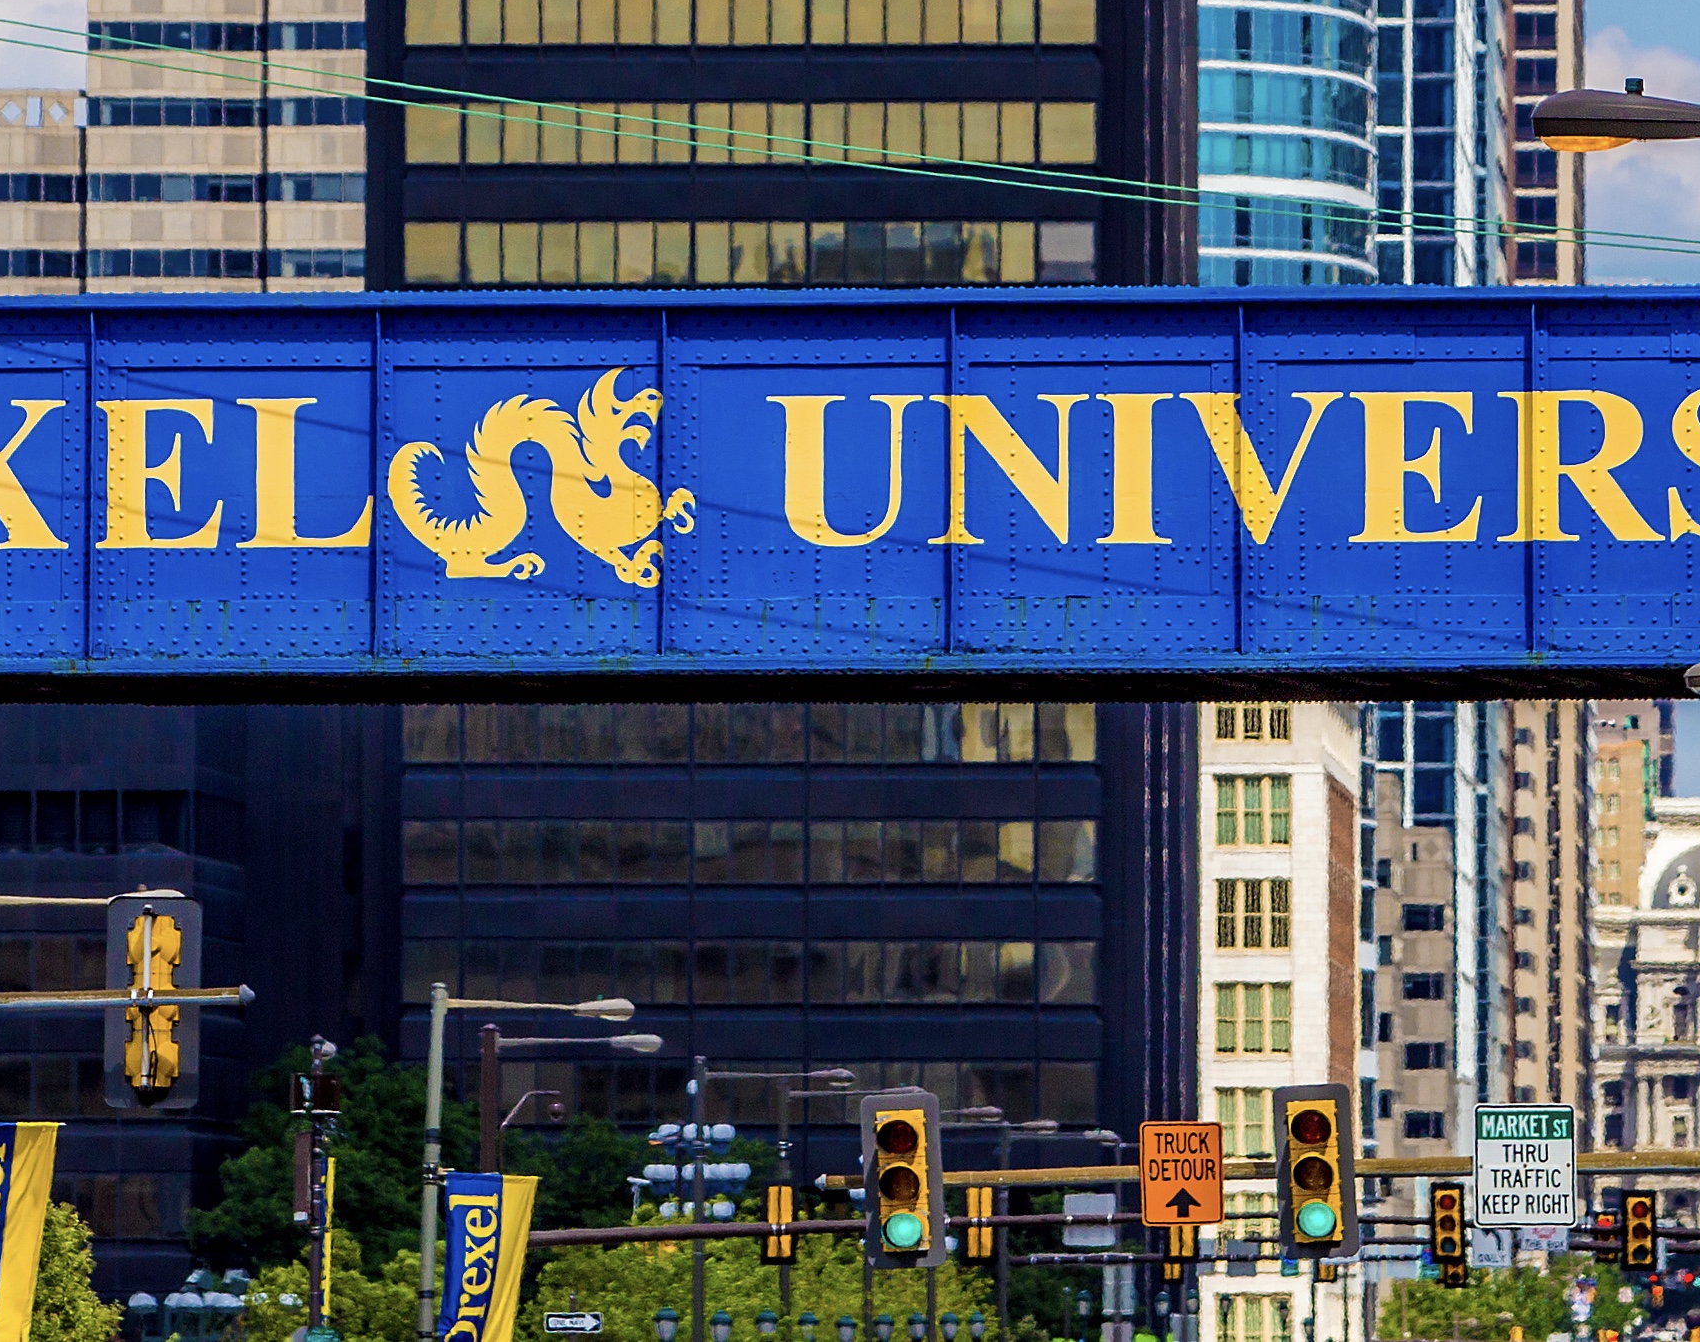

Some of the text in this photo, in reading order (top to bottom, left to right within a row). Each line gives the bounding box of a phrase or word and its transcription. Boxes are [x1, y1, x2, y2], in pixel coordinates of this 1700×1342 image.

[1481, 1114, 1568, 1138] MARKET ST
[1154, 1132, 1210, 1154] TRUCK
[1502, 1144, 1549, 1163] THRU
[1148, 1158, 1216, 1181] DETOUR
[1490, 1169, 1561, 1188] TRAFFIC
[1482, 1194, 1569, 1215] KEEP RIGHT
